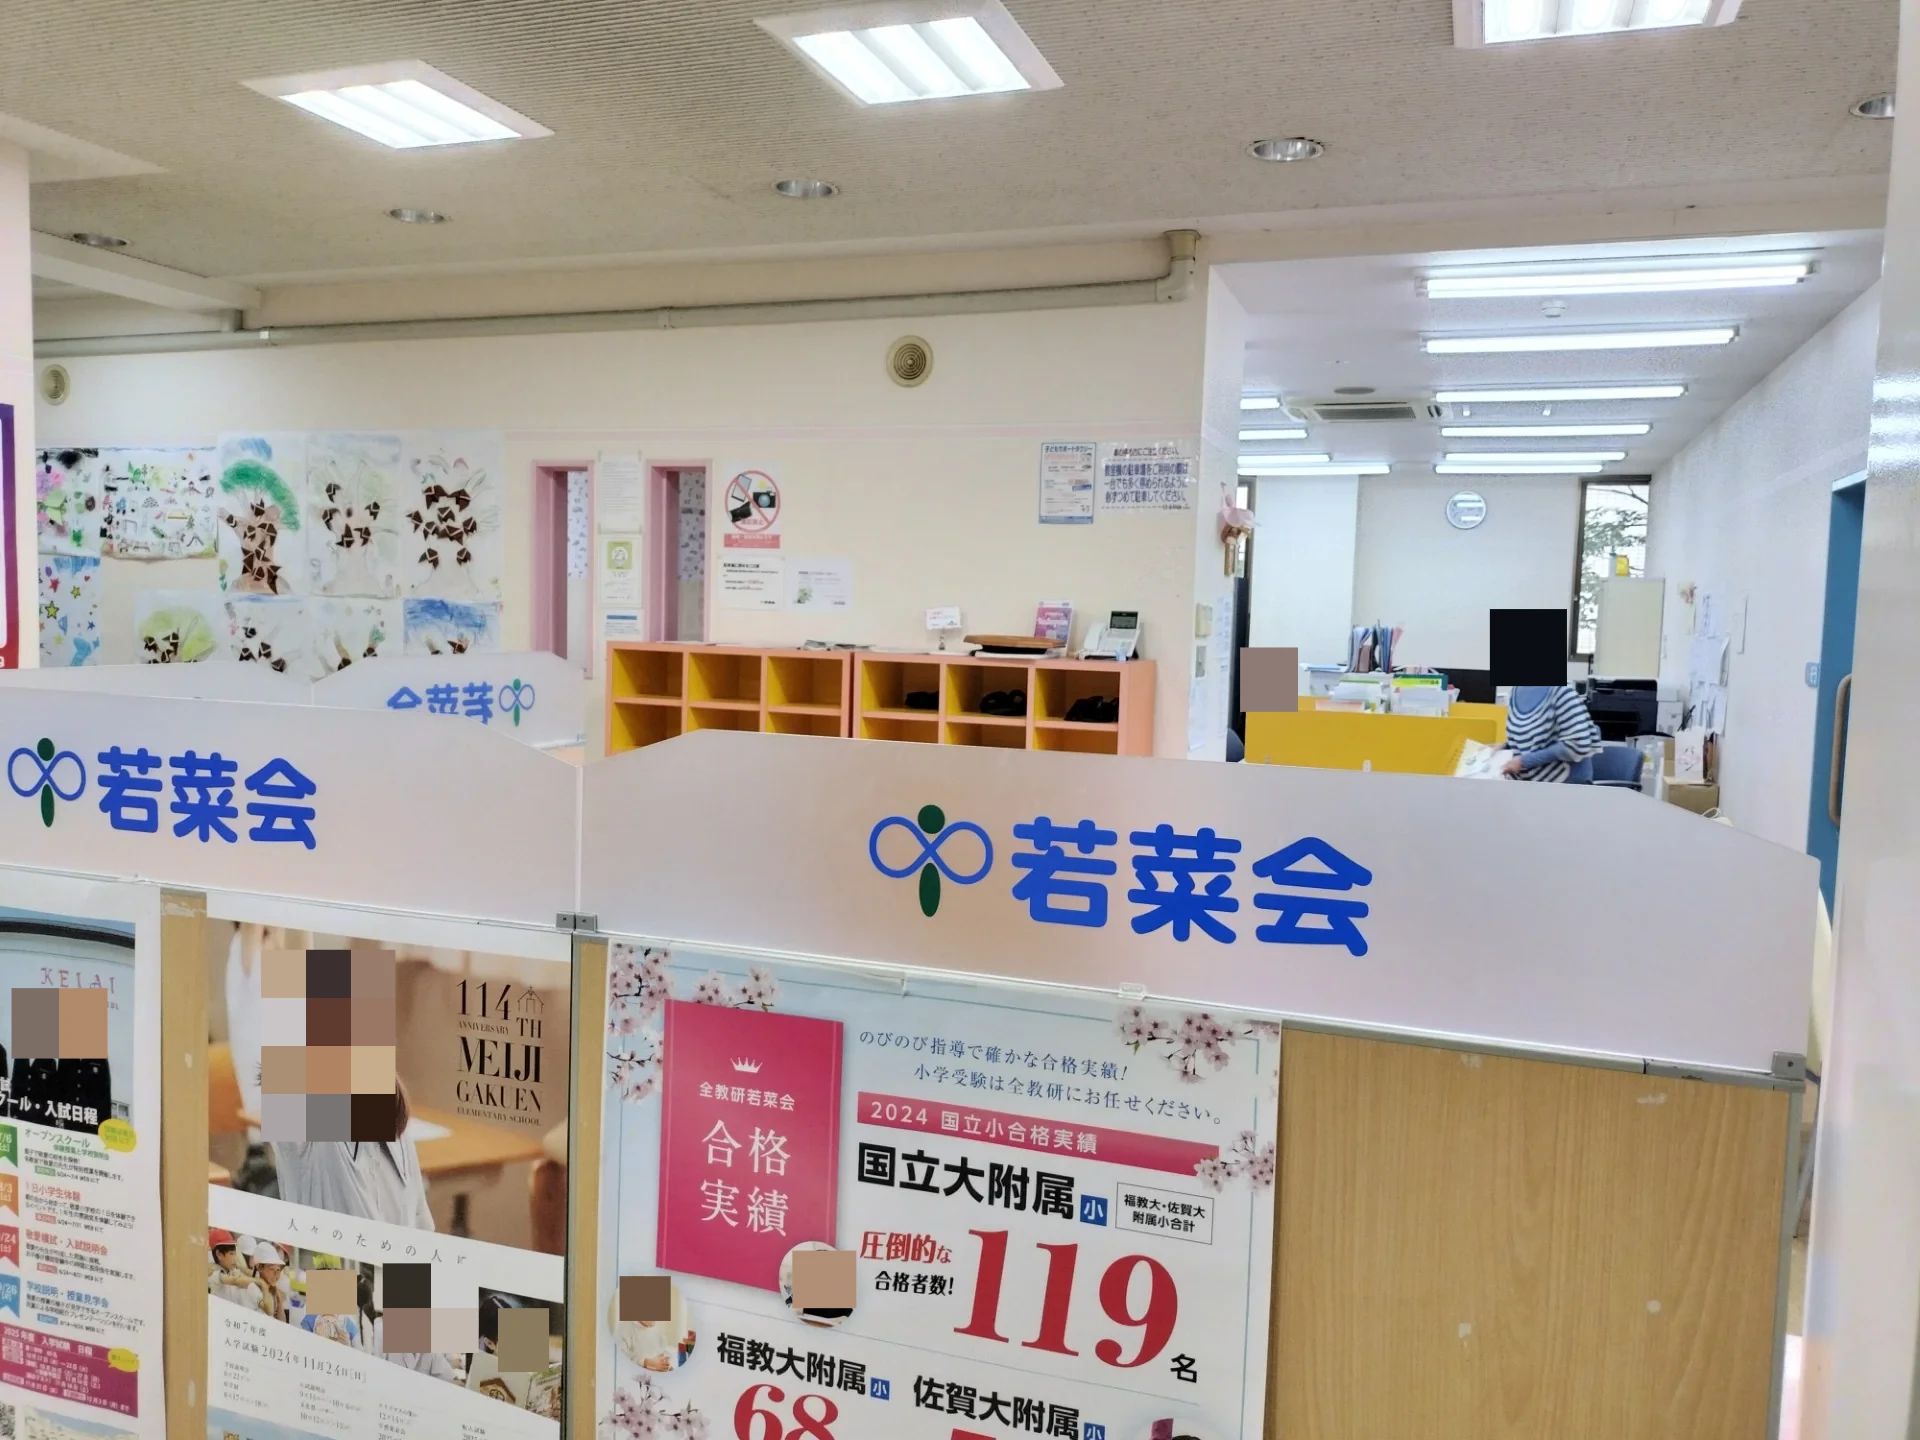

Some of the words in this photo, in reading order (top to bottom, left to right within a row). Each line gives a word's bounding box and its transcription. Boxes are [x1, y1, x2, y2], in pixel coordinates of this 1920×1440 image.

[97, 746, 317, 850] 若菜会
[1011, 816, 1373, 957] 若菜会
[41, 967, 116, 994] KEIAI
[456, 979, 511, 1020] 114
[516, 1016, 542, 1039] TH
[458, 1020, 510, 1036] ANNIVERSARY
[457, 1034, 544, 1083] MEIJI
[859, 1030, 1128, 1081] のびのび指導で確かな合格実績!
[456, 1079, 543, 1113] GAKUEN
[457, 1106, 507, 1122] ELEMENTARY
[510, 1114, 542, 1127] SCHOOL
[699, 1081, 796, 1112] 全教研若菜会
[914, 1063, 1221, 1125] 小学受験は全教研にお任せください。
[702, 1119, 791, 1177] 合格
[870, 1100, 929, 1125] 2024
[940, 1110, 1098, 1155] 国立小合格実績
[701, 1178, 789, 1237] 実績
[858, 1142, 1075, 1220] 国立大附属
[1123, 1193, 1206, 1220] 福教大・佐賀大
[859, 1230, 952, 1265] 圧倒的な
[1131, 1210, 1196, 1233] 附属小合計
[874, 1270, 954, 1296] 合格者数!
[953, 1229, 1179, 1368] 119
[1170, 1353, 1199, 1384] 名
[225, 1318, 267, 1337] 令和7年度
[717, 1332, 867, 1396] 福教大附属
[734, 1383, 839, 1440] 68
[913, 1374, 1079, 1440] 佐賀大附属
